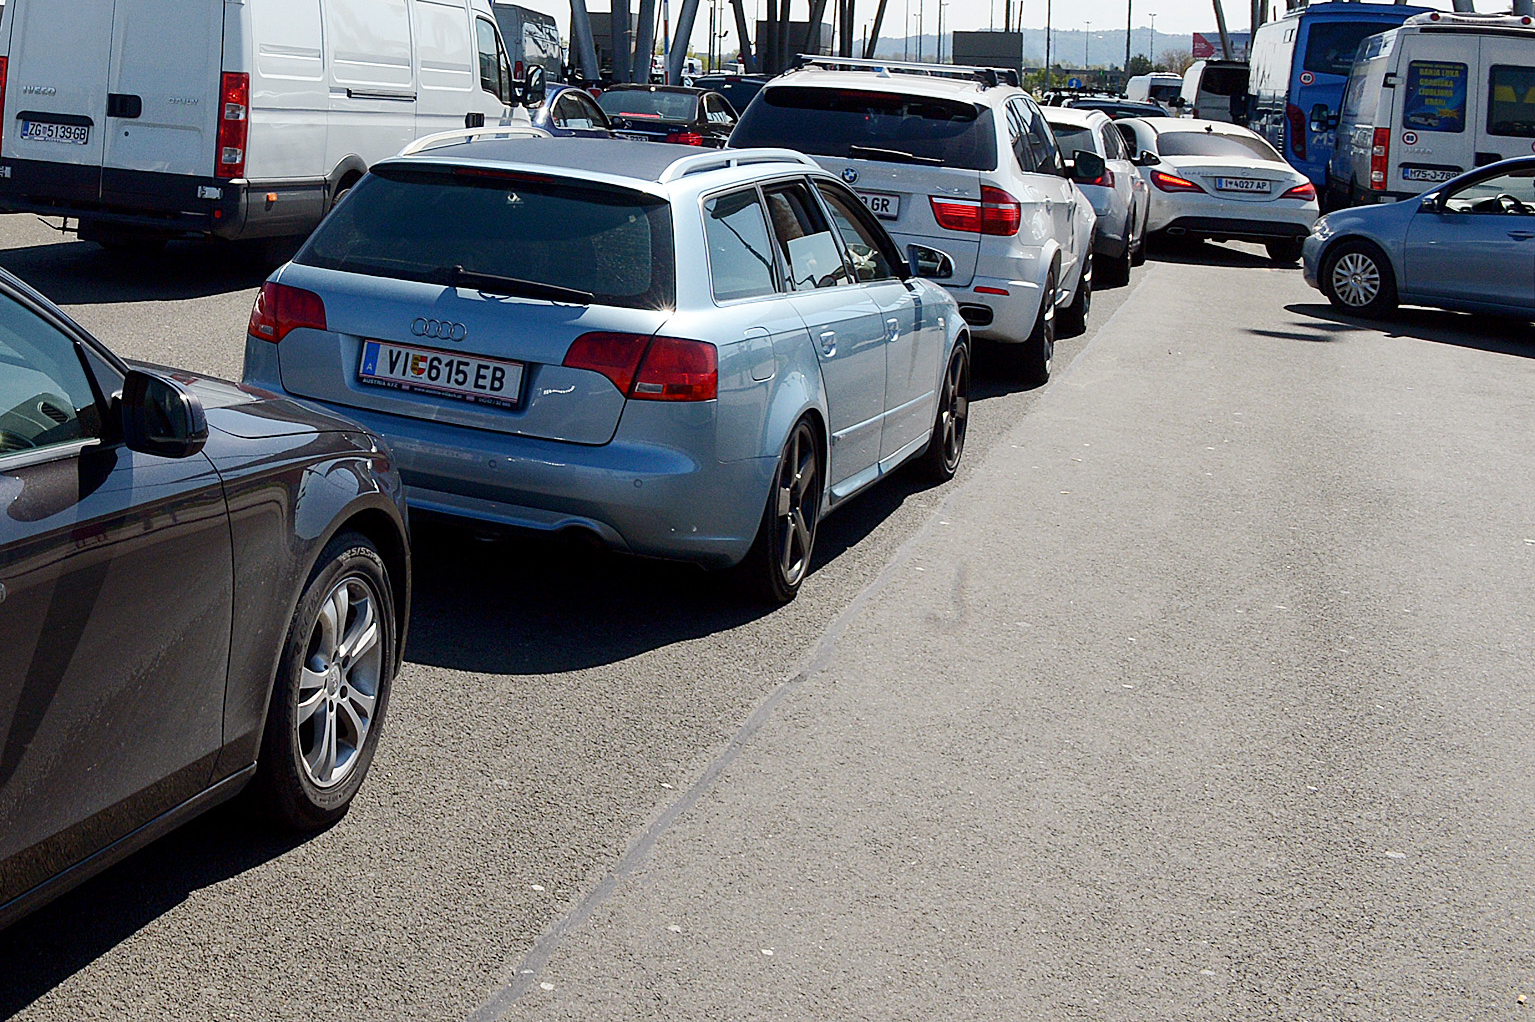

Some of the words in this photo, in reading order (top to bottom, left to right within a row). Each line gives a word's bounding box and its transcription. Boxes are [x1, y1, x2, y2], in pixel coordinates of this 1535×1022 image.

[22, 85, 57, 97] IVECO
[28, 123, 42, 137] ZG
[46, 124, 87, 141] 5139-GB
[1233, 181, 1254, 189] 4027
[1255, 182, 1267, 190] AP
[870, 198, 890, 213] GR
[365, 363, 373, 371] A
[388, 349, 410, 377] VI
[426, 356, 471, 386] 615
[473, 363, 506, 392] EB
[362, 378, 386, 386] AUSTRIA
